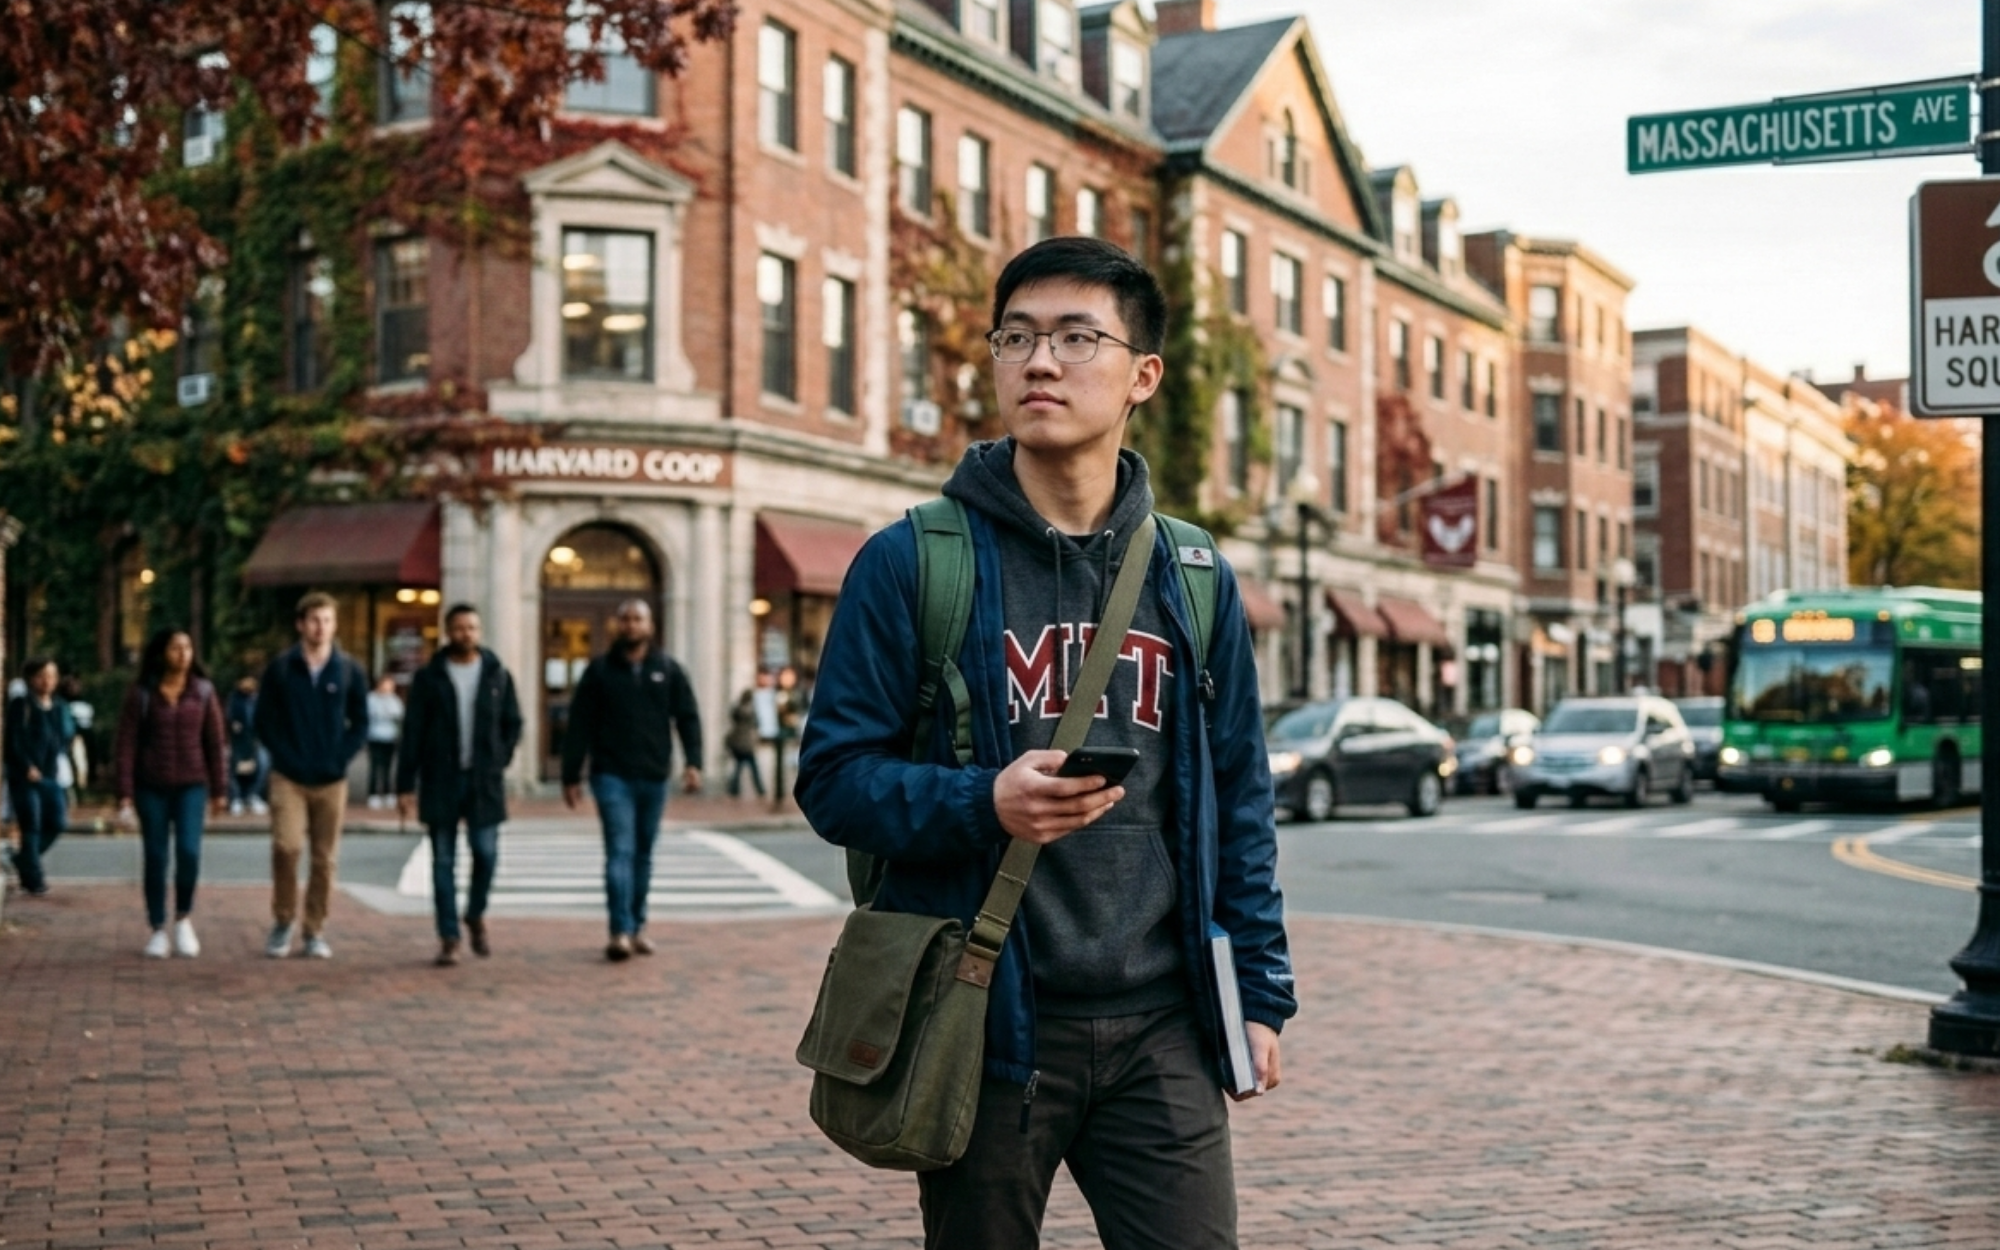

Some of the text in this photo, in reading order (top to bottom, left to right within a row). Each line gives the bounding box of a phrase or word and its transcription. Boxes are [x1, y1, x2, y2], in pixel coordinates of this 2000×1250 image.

[1637, 95, 1958, 164] MASSACHUSETTS AVE
[1935, 314, 2000, 347] HAR
[493, 447, 723, 483] HARVARD COOP
